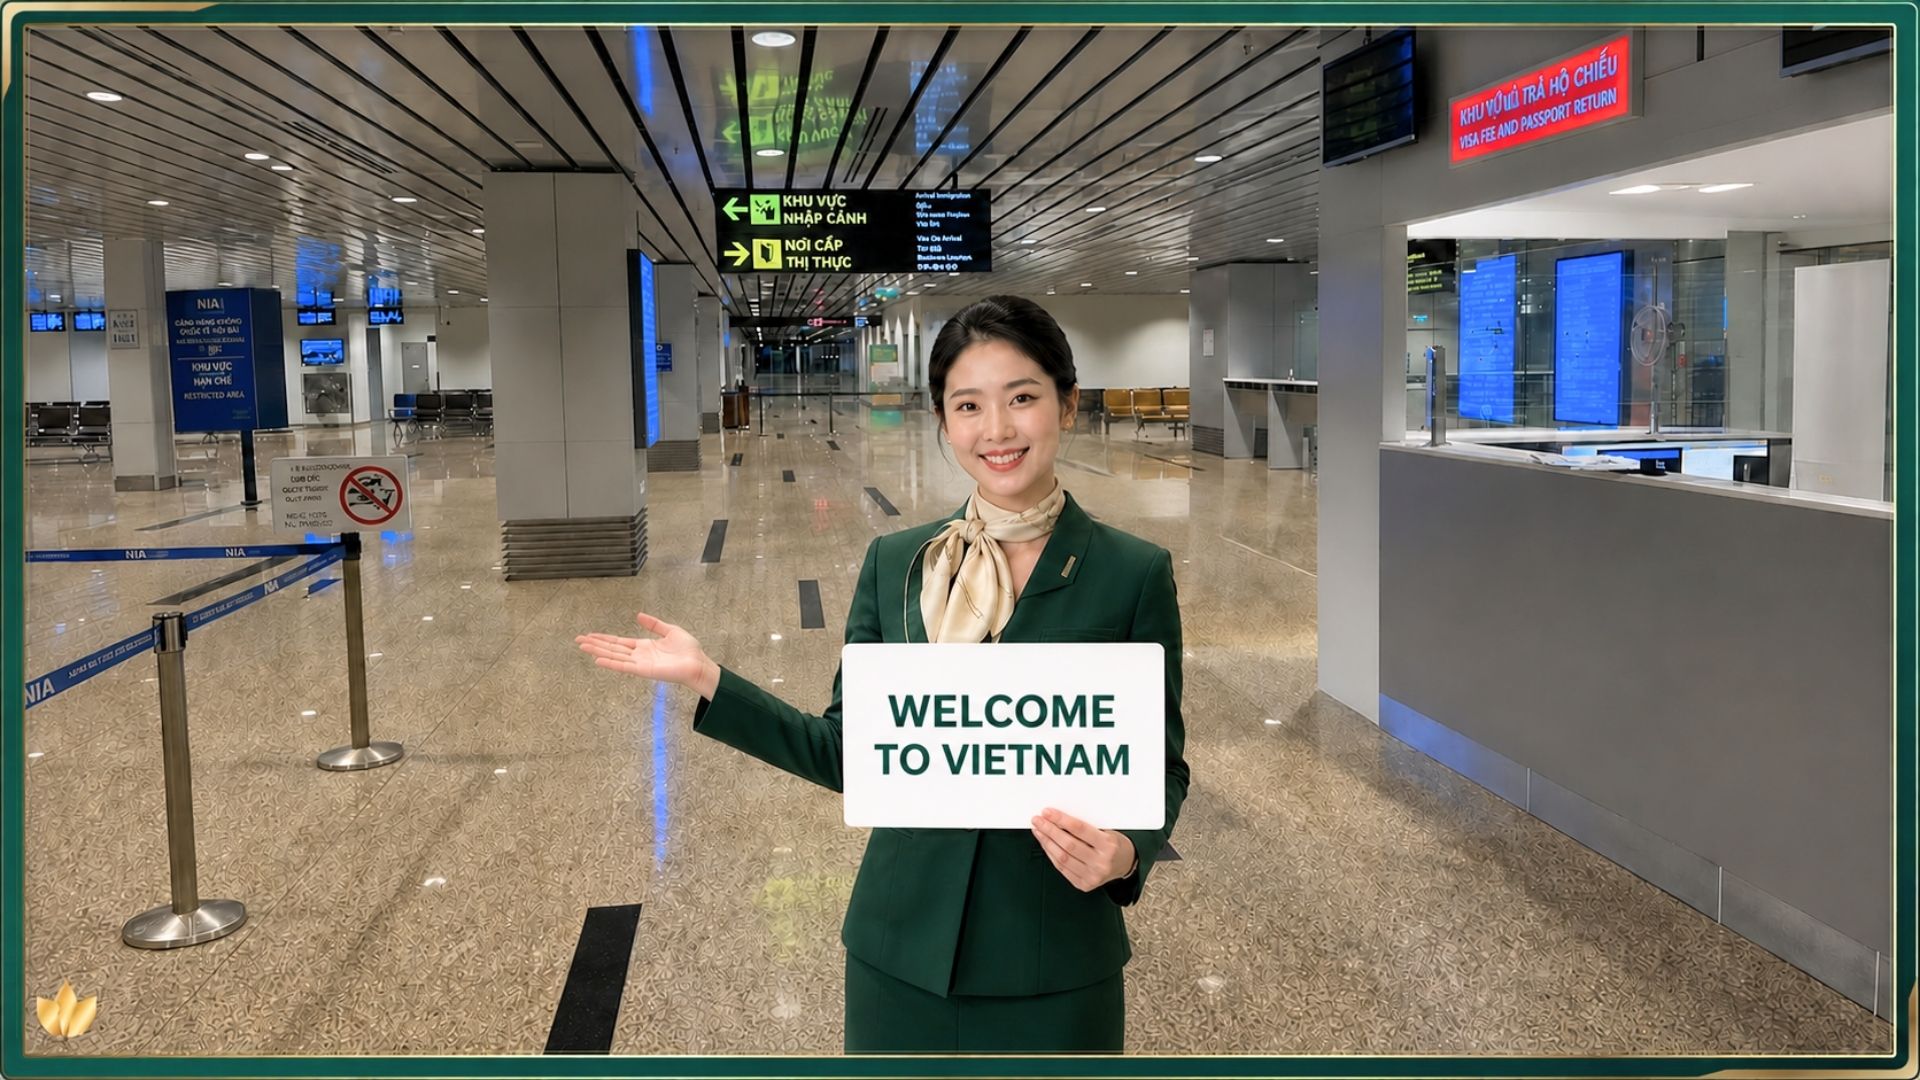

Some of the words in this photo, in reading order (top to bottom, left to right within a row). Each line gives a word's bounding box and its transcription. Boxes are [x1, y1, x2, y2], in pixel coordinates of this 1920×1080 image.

[1460, 102, 1484, 126] KHU
[1549, 68, 1569, 97] HỘ
[1573, 46, 1618, 87] CHIẾU
[1459, 132, 1479, 150] VISA
[1480, 126, 1496, 144] FEE
[1497, 119, 1519, 140] AND
[1520, 101, 1571, 132] PASSPORT
[1574, 87, 1617, 116] RETURN
[782, 194, 814, 208] KHU
[816, 193, 847, 211] VỰC
[783, 209, 823, 229] NHẬP
[826, 209, 867, 225] CẢNH
[814, 234, 844, 252] CẤP
[786, 256, 809, 271] THỊ
[811, 255, 852, 271] THỰC
[197, 298, 220, 310] NIA
[125, 550, 147, 559] NIA
[225, 548, 246, 557] NIA
[888, 693, 1115, 728] WELCOME
[874, 743, 930, 776] TO
[941, 743, 1130, 776] VIETNAM
